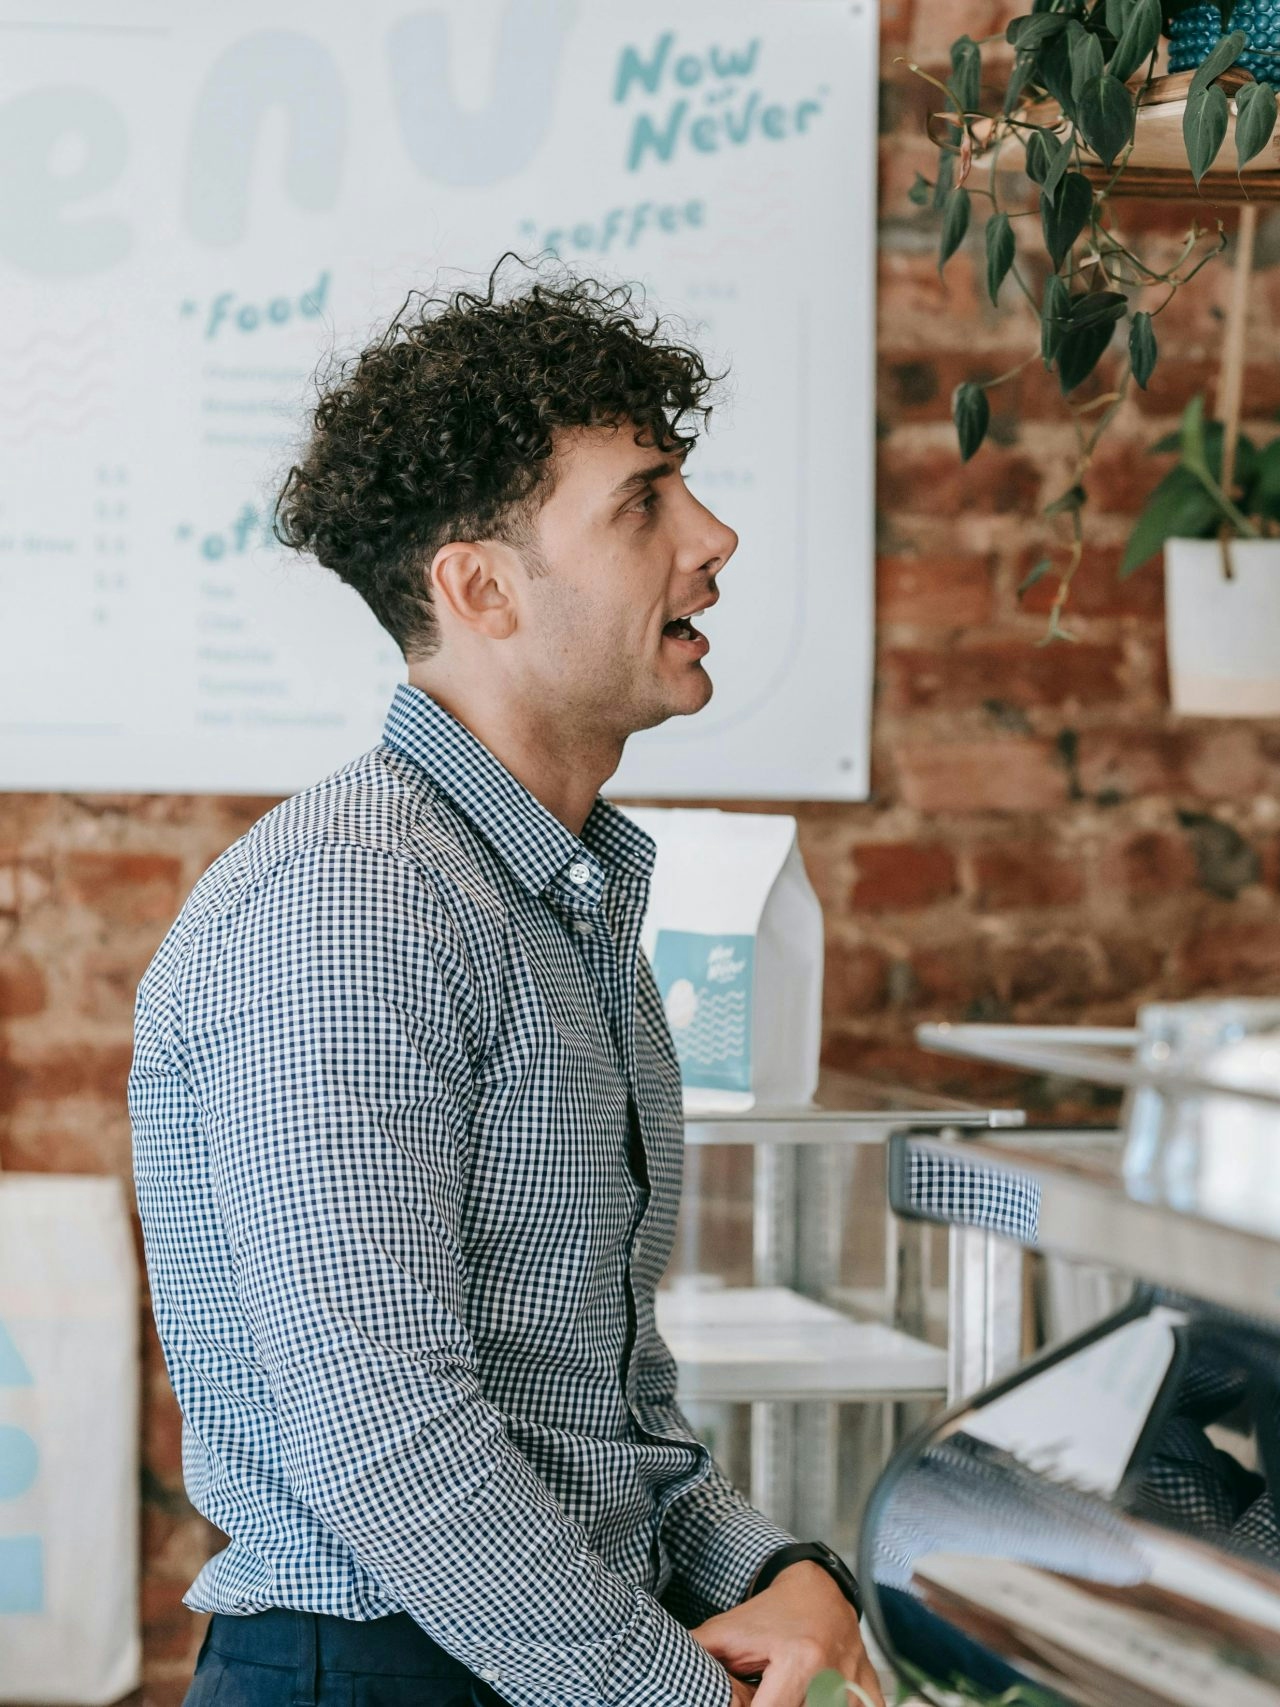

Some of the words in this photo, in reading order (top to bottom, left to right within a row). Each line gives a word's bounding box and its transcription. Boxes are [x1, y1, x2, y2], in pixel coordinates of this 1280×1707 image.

[612, 29, 764, 104] Now
[624, 90, 824, 172] Never
[203, 270, 335, 341] food
